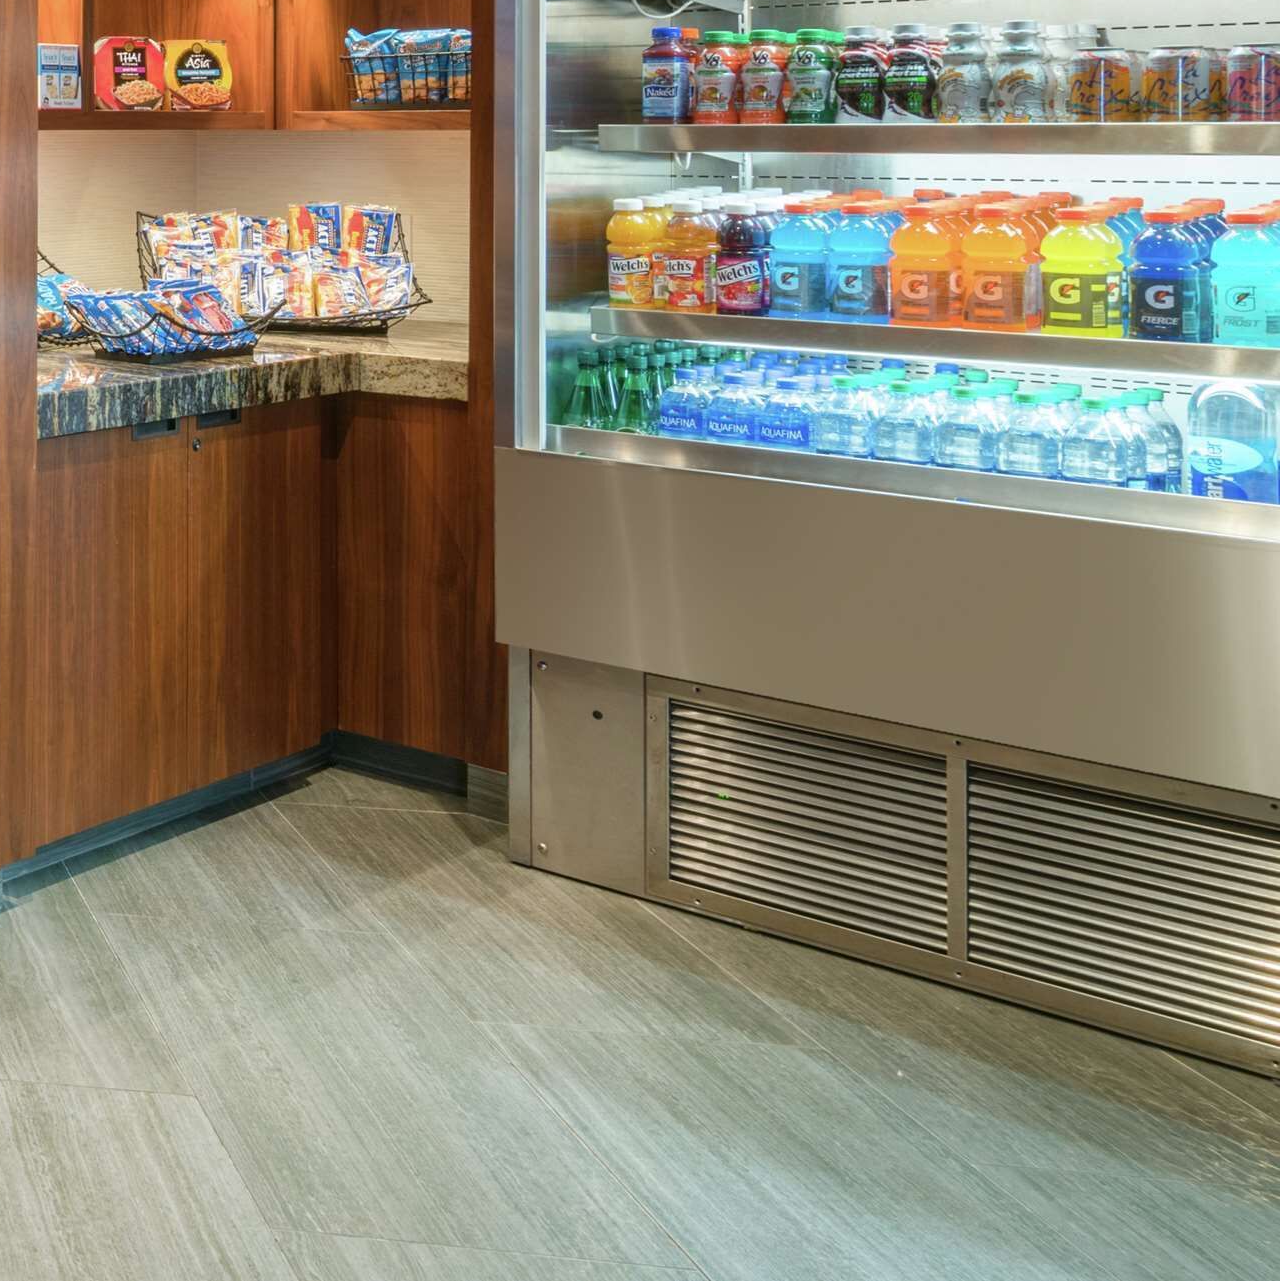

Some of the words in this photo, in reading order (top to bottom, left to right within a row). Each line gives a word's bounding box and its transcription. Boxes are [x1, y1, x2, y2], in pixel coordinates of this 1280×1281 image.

[116, 51, 142, 64] THAI
[184, 56, 213, 69] Asia
[703, 51, 719, 67] V8
[752, 50, 769, 65] V8
[796, 49, 814, 65] V8
[646, 86, 676, 98] Naked
[611, 257, 649, 272] Welch's
[718, 262, 759, 282] Welch's
[775, 266, 799, 291] G
[838, 269, 863, 294] G
[900, 273, 929, 300] G
[973, 274, 1003, 301] G
[1049, 277, 1081, 305] G
[1144, 284, 1175, 310] G
[1225, 285, 1257, 313] G
[1140, 314, 1180, 326] FIERCE
[1223, 318, 1260, 328] FROST
[708, 420, 751, 436] AQUAFINA
[760, 425, 806, 442] AQUAFINA
